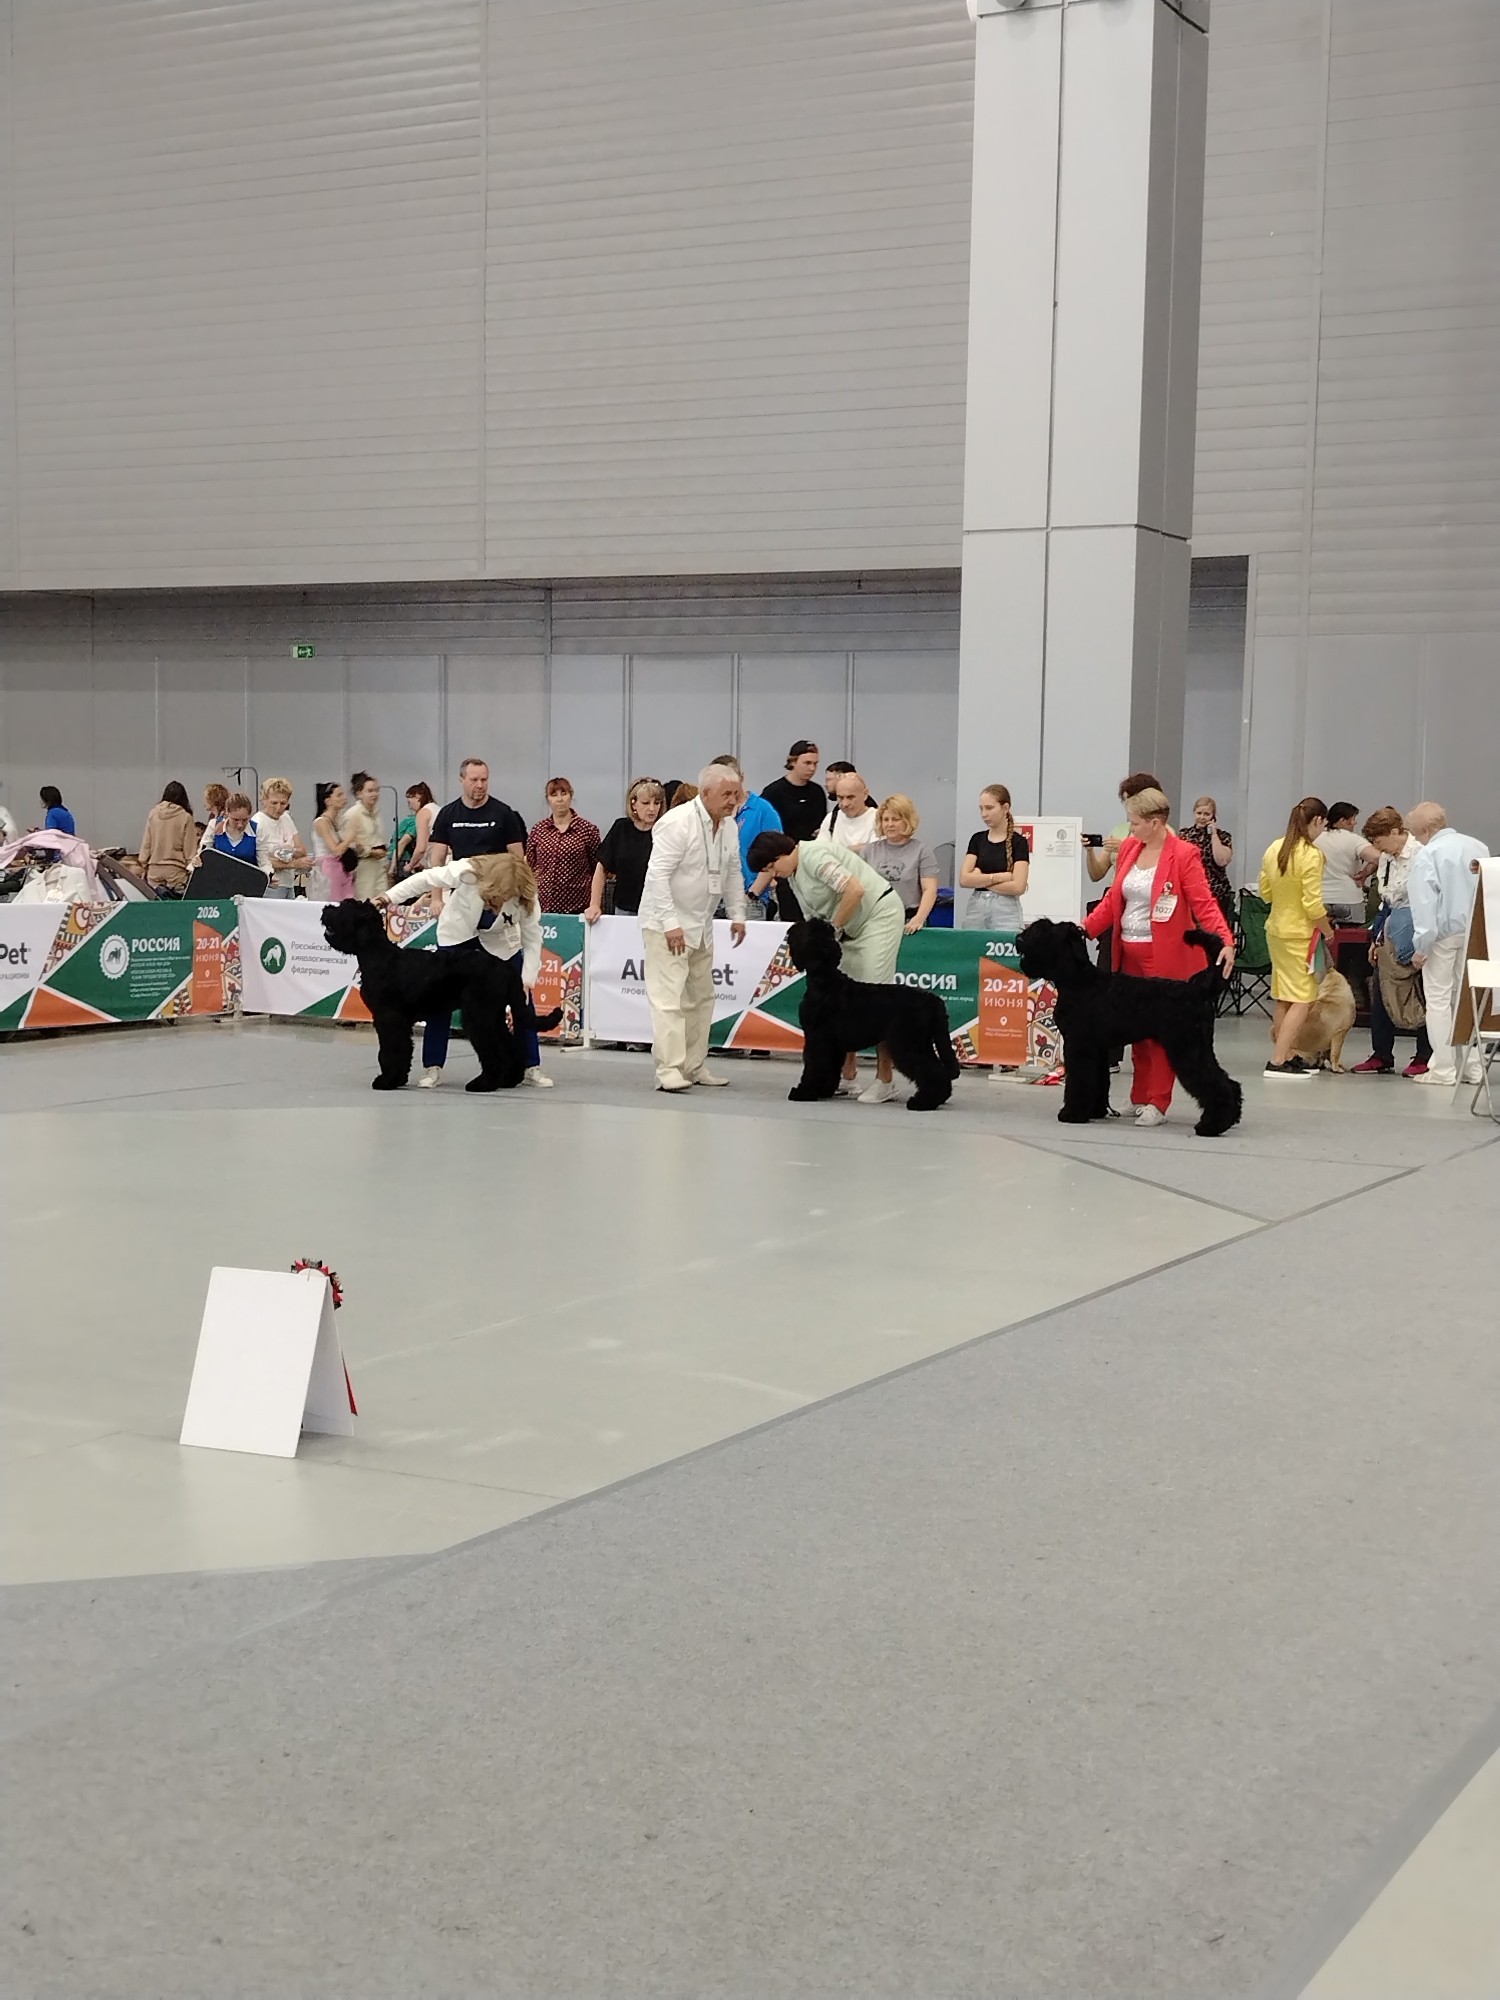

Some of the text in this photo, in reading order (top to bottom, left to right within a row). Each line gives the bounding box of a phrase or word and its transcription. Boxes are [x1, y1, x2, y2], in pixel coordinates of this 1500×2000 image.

[196, 906, 220, 919] 2026
[541, 925, 558, 939] 26
[131, 936, 181, 953] РОССИЯ
[196, 936, 220, 950] 20-21
[541, 959, 559, 972] -21
[893, 972, 957, 990] ОССИЯ
[984, 978, 1024, 993] 20-21
